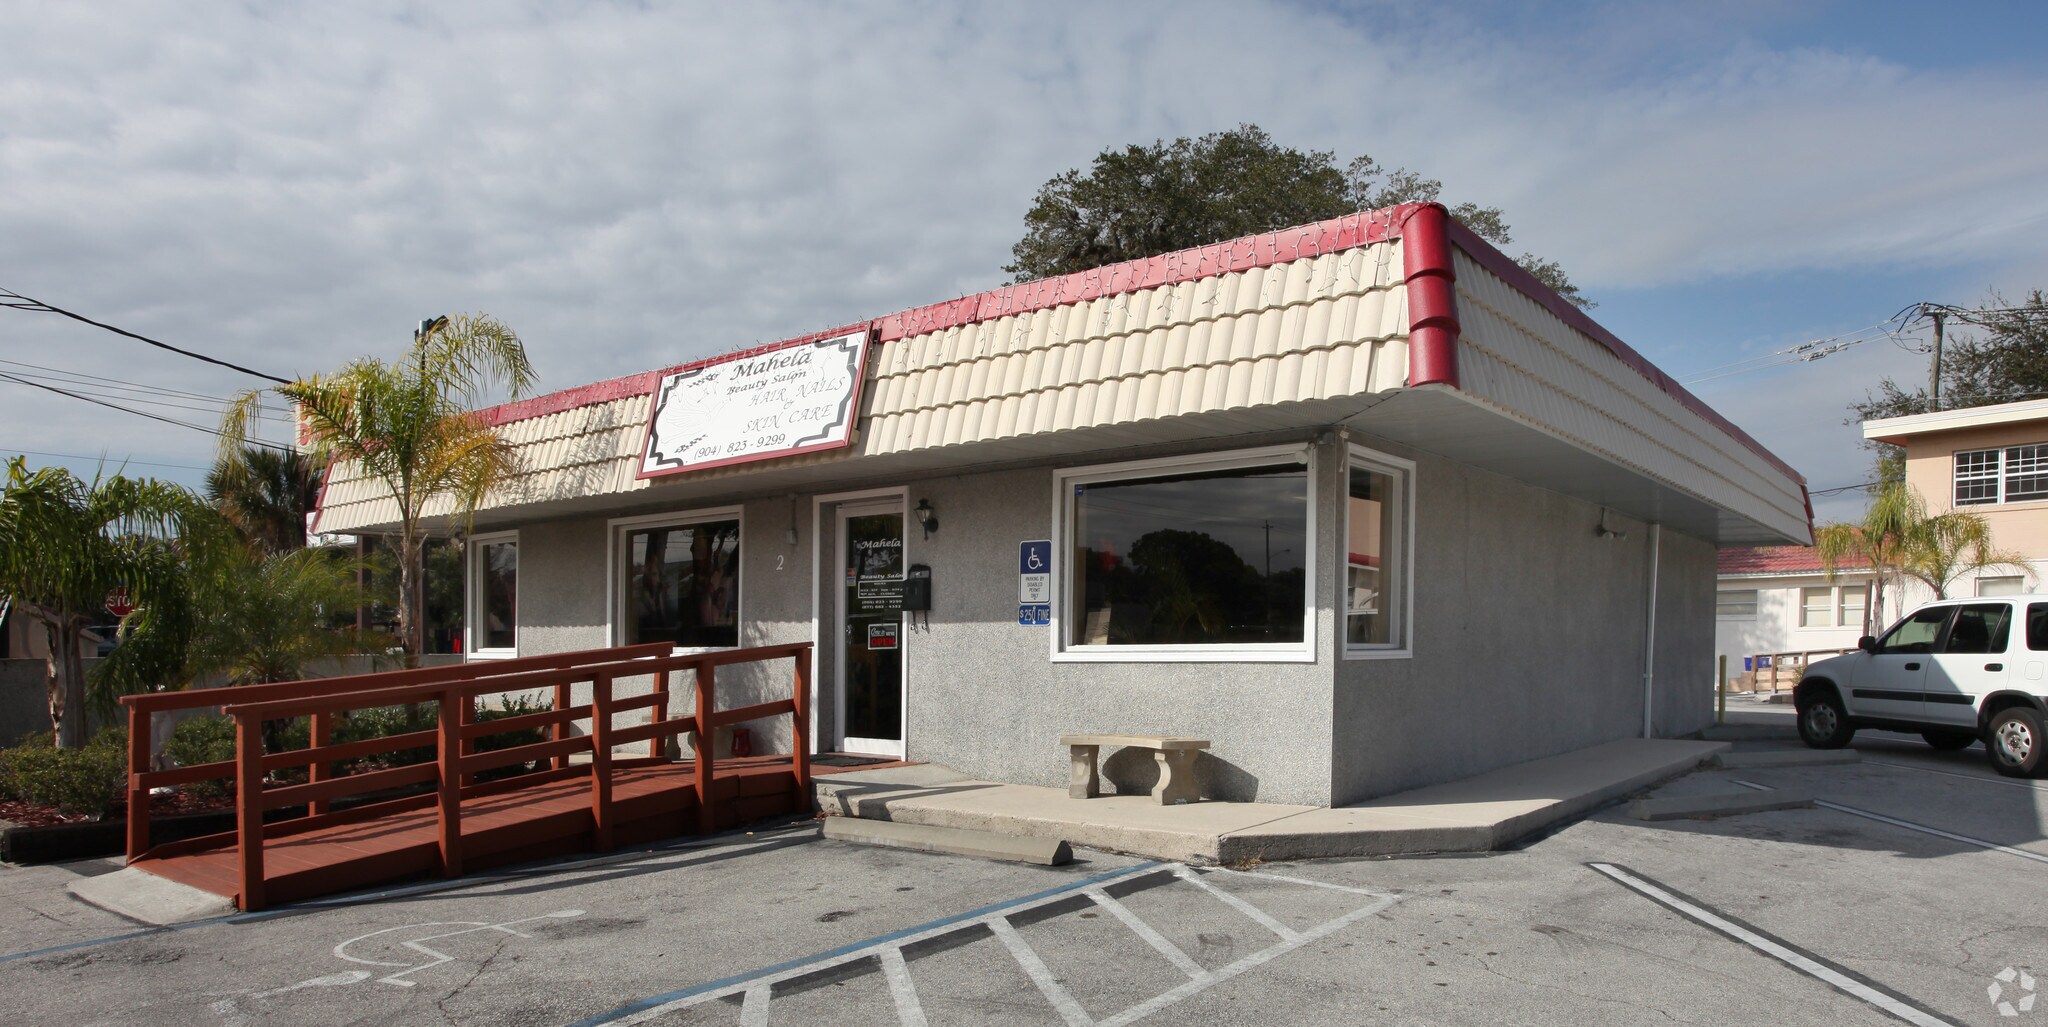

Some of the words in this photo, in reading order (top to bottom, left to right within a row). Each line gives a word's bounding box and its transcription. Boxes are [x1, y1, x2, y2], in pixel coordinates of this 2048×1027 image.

[729, 348, 813, 381] Mahela
[726, 379, 768, 395] Beauty
[771, 369, 807, 383] Salon
[748, 387, 787, 407] HAIR
[796, 376, 846, 398] NAILS
[742, 411, 784, 434] SKIN
[788, 404, 834, 424] CARE
[693, 445, 722, 460] (904)
[726, 440, 748, 453] 823
[756, 433, 786, 448] 9299
[860, 538, 902, 549] Mahela
[775, 554, 784, 571] 2
[106, 595, 134, 607] STO
[1037, 609, 1050, 621] FINE
[871, 637, 896, 647] OPEN
